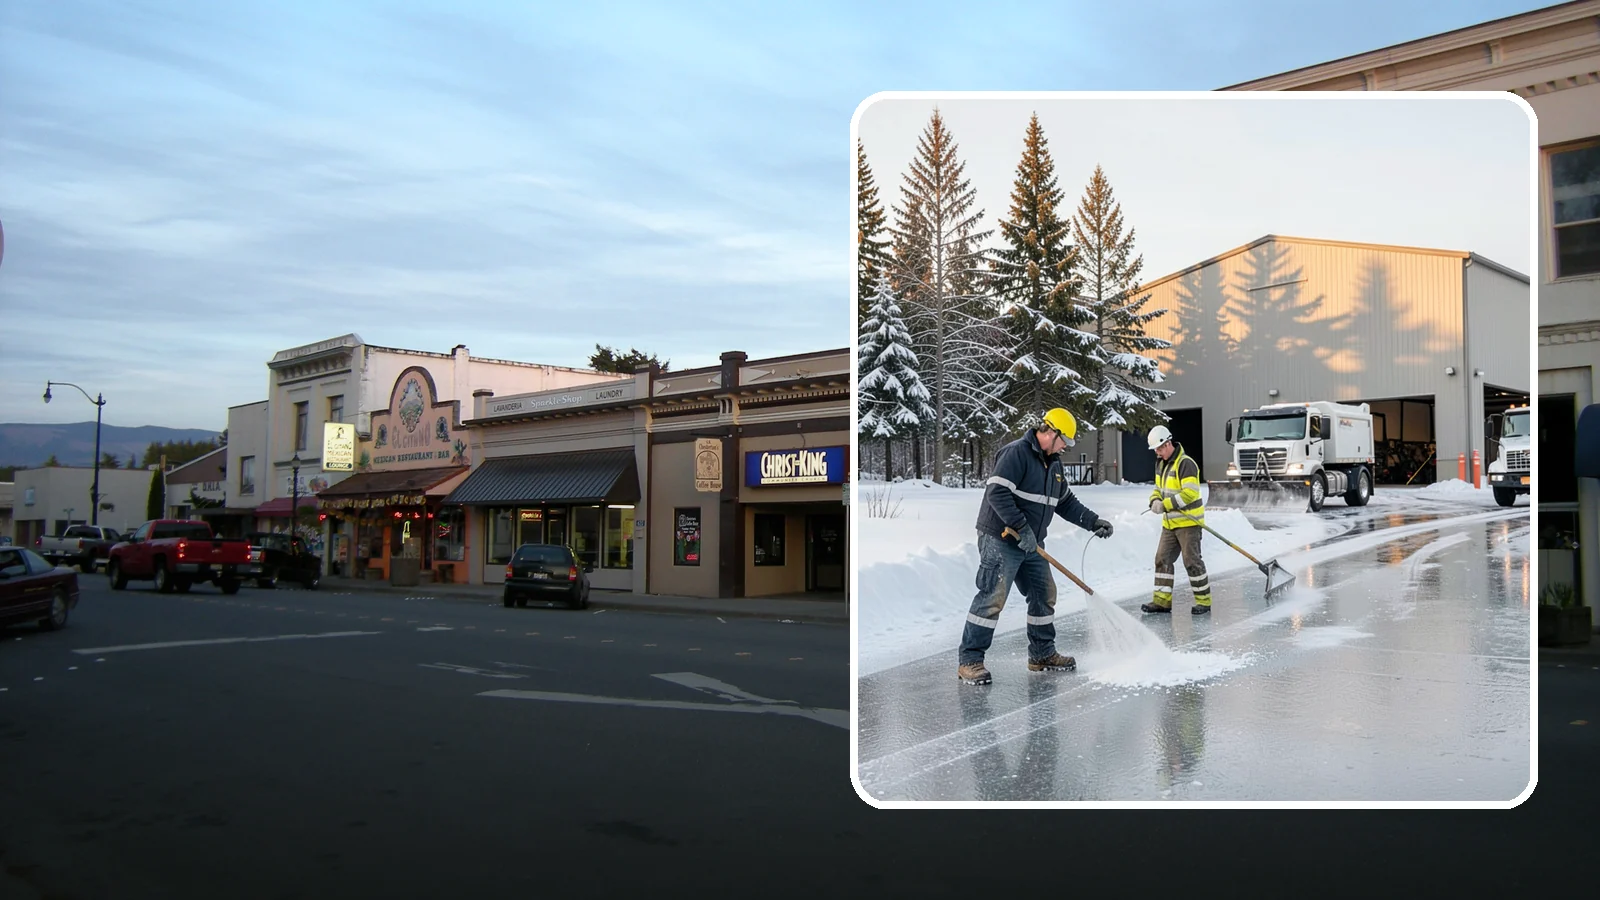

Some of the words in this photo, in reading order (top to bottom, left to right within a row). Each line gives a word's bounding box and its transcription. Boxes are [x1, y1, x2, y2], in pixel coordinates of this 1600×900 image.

[596, 388, 623, 400] LAUNDRY
[494, 402, 522, 412] LAVANDERIA
[562, 395, 582, 408] Shop
[373, 455, 396, 464] MEXICAN
[398, 452, 433, 462] RESTAURANT
[438, 451, 450, 459] BAR
